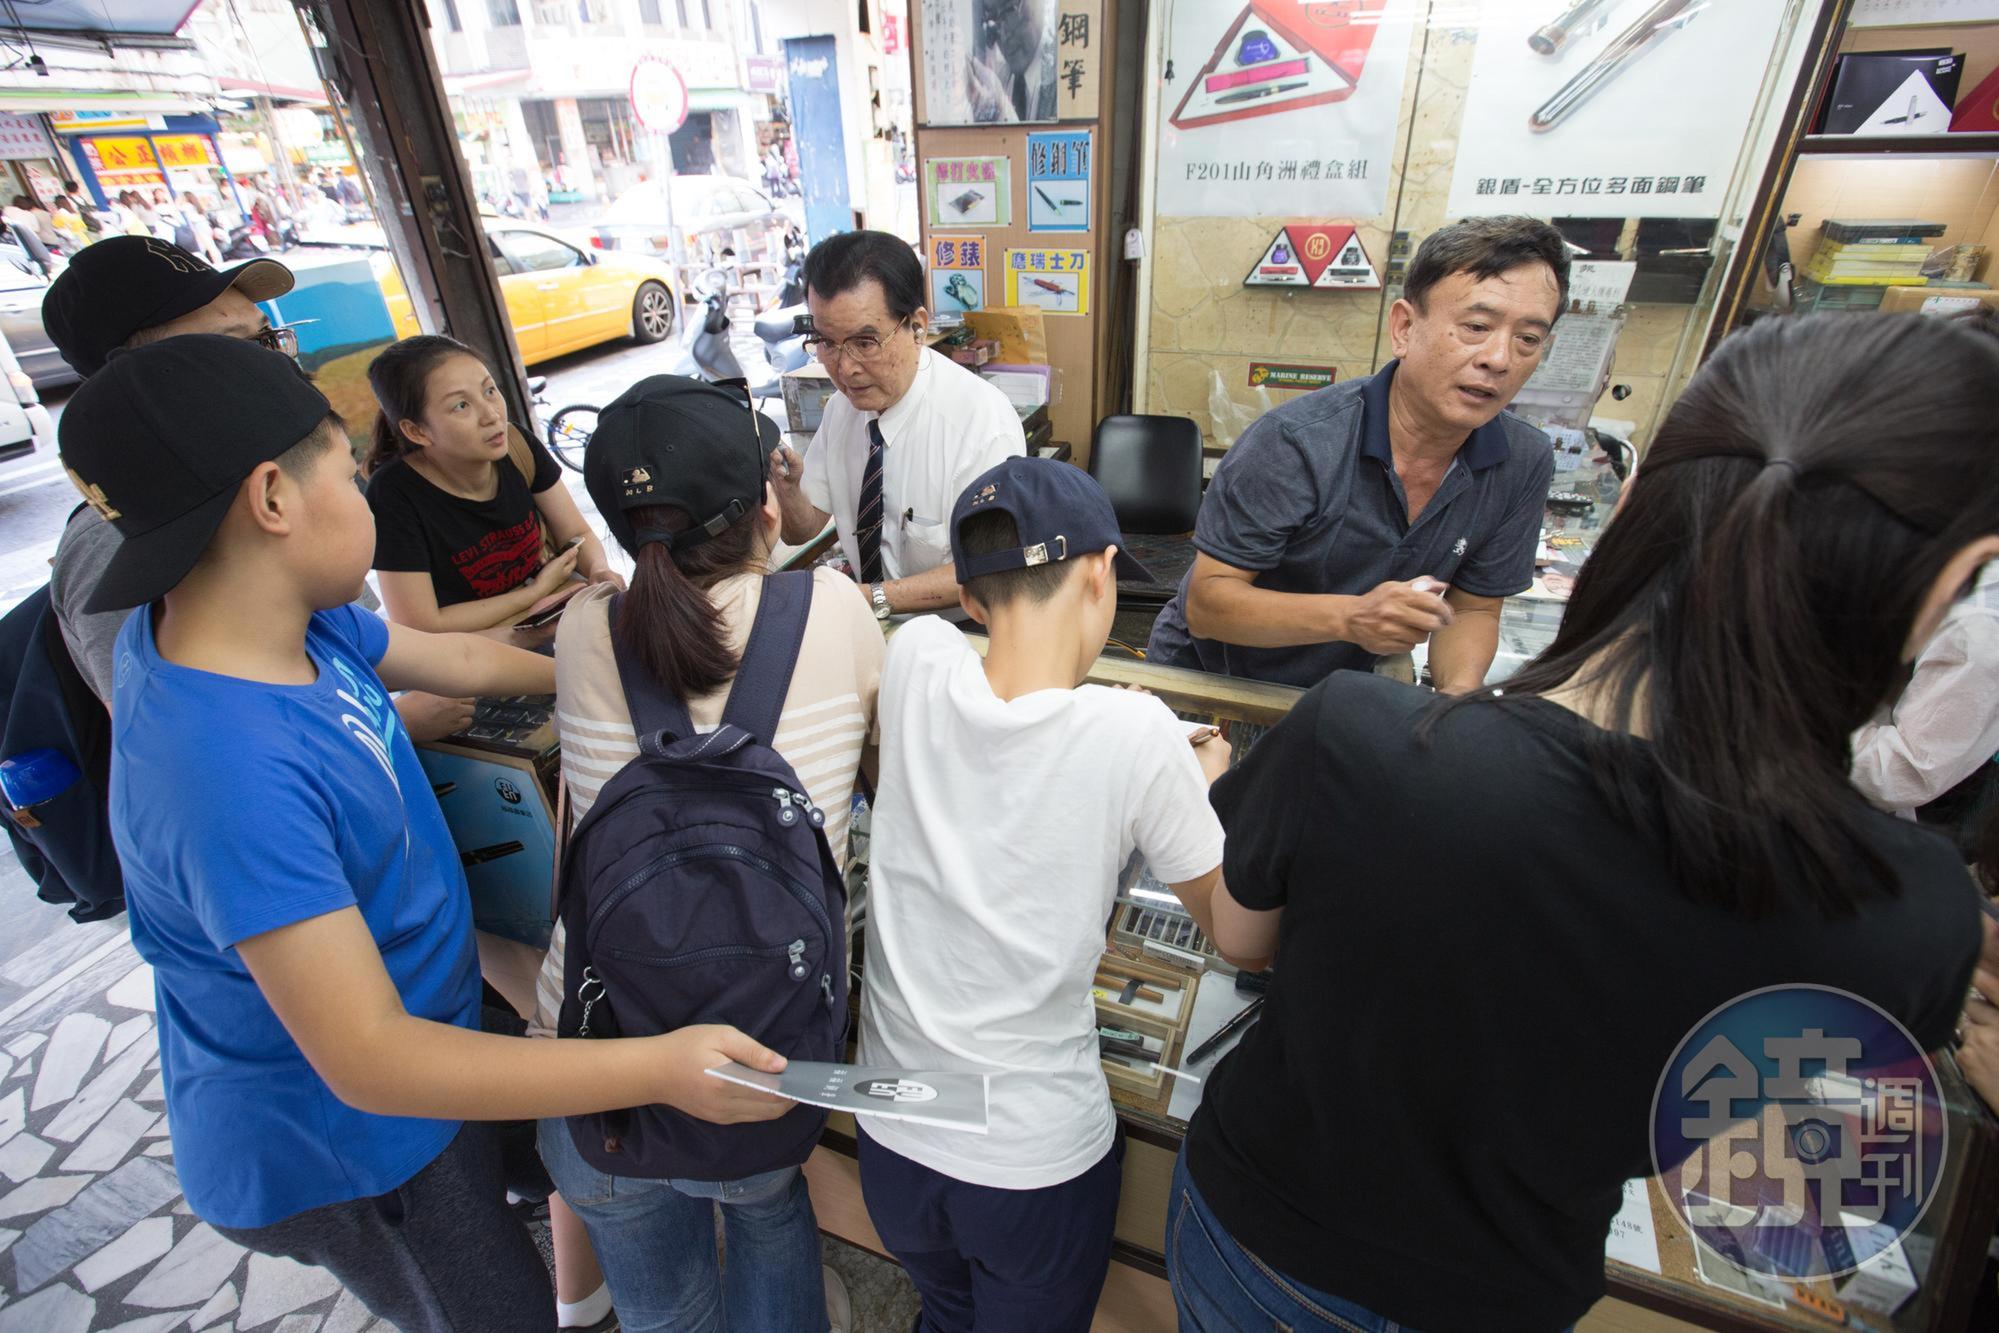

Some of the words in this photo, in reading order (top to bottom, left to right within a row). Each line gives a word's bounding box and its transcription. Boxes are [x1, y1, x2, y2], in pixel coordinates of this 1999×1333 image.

[1476, 175, 1707, 195] 銀盾-全方位多面鋼筆
[936, 241, 980, 266] 修錶
